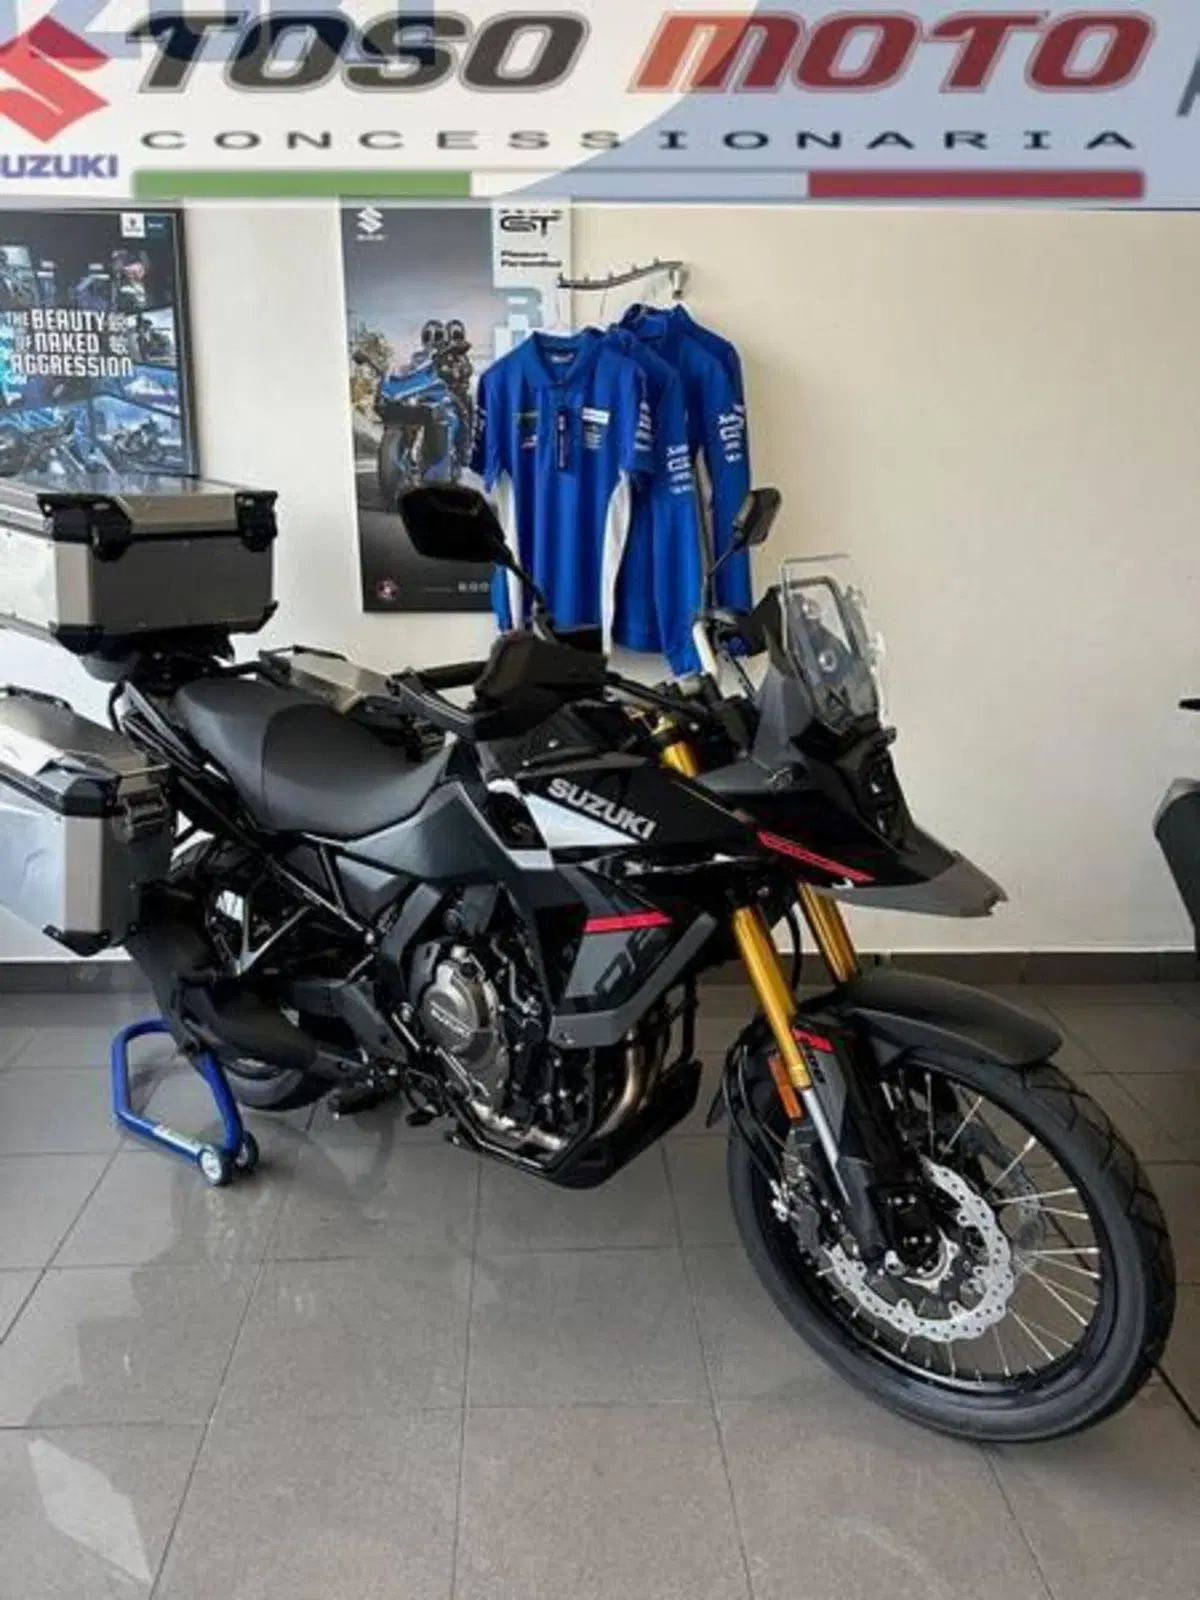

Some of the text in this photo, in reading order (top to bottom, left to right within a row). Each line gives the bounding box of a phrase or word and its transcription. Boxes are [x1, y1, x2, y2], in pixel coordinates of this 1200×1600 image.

[31, 309, 105, 331] BEAUTY
[35, 333, 99, 352] NAKED
[10, 354, 133, 377] AGGRESSION
[547, 778, 656, 840] SUZUKI
